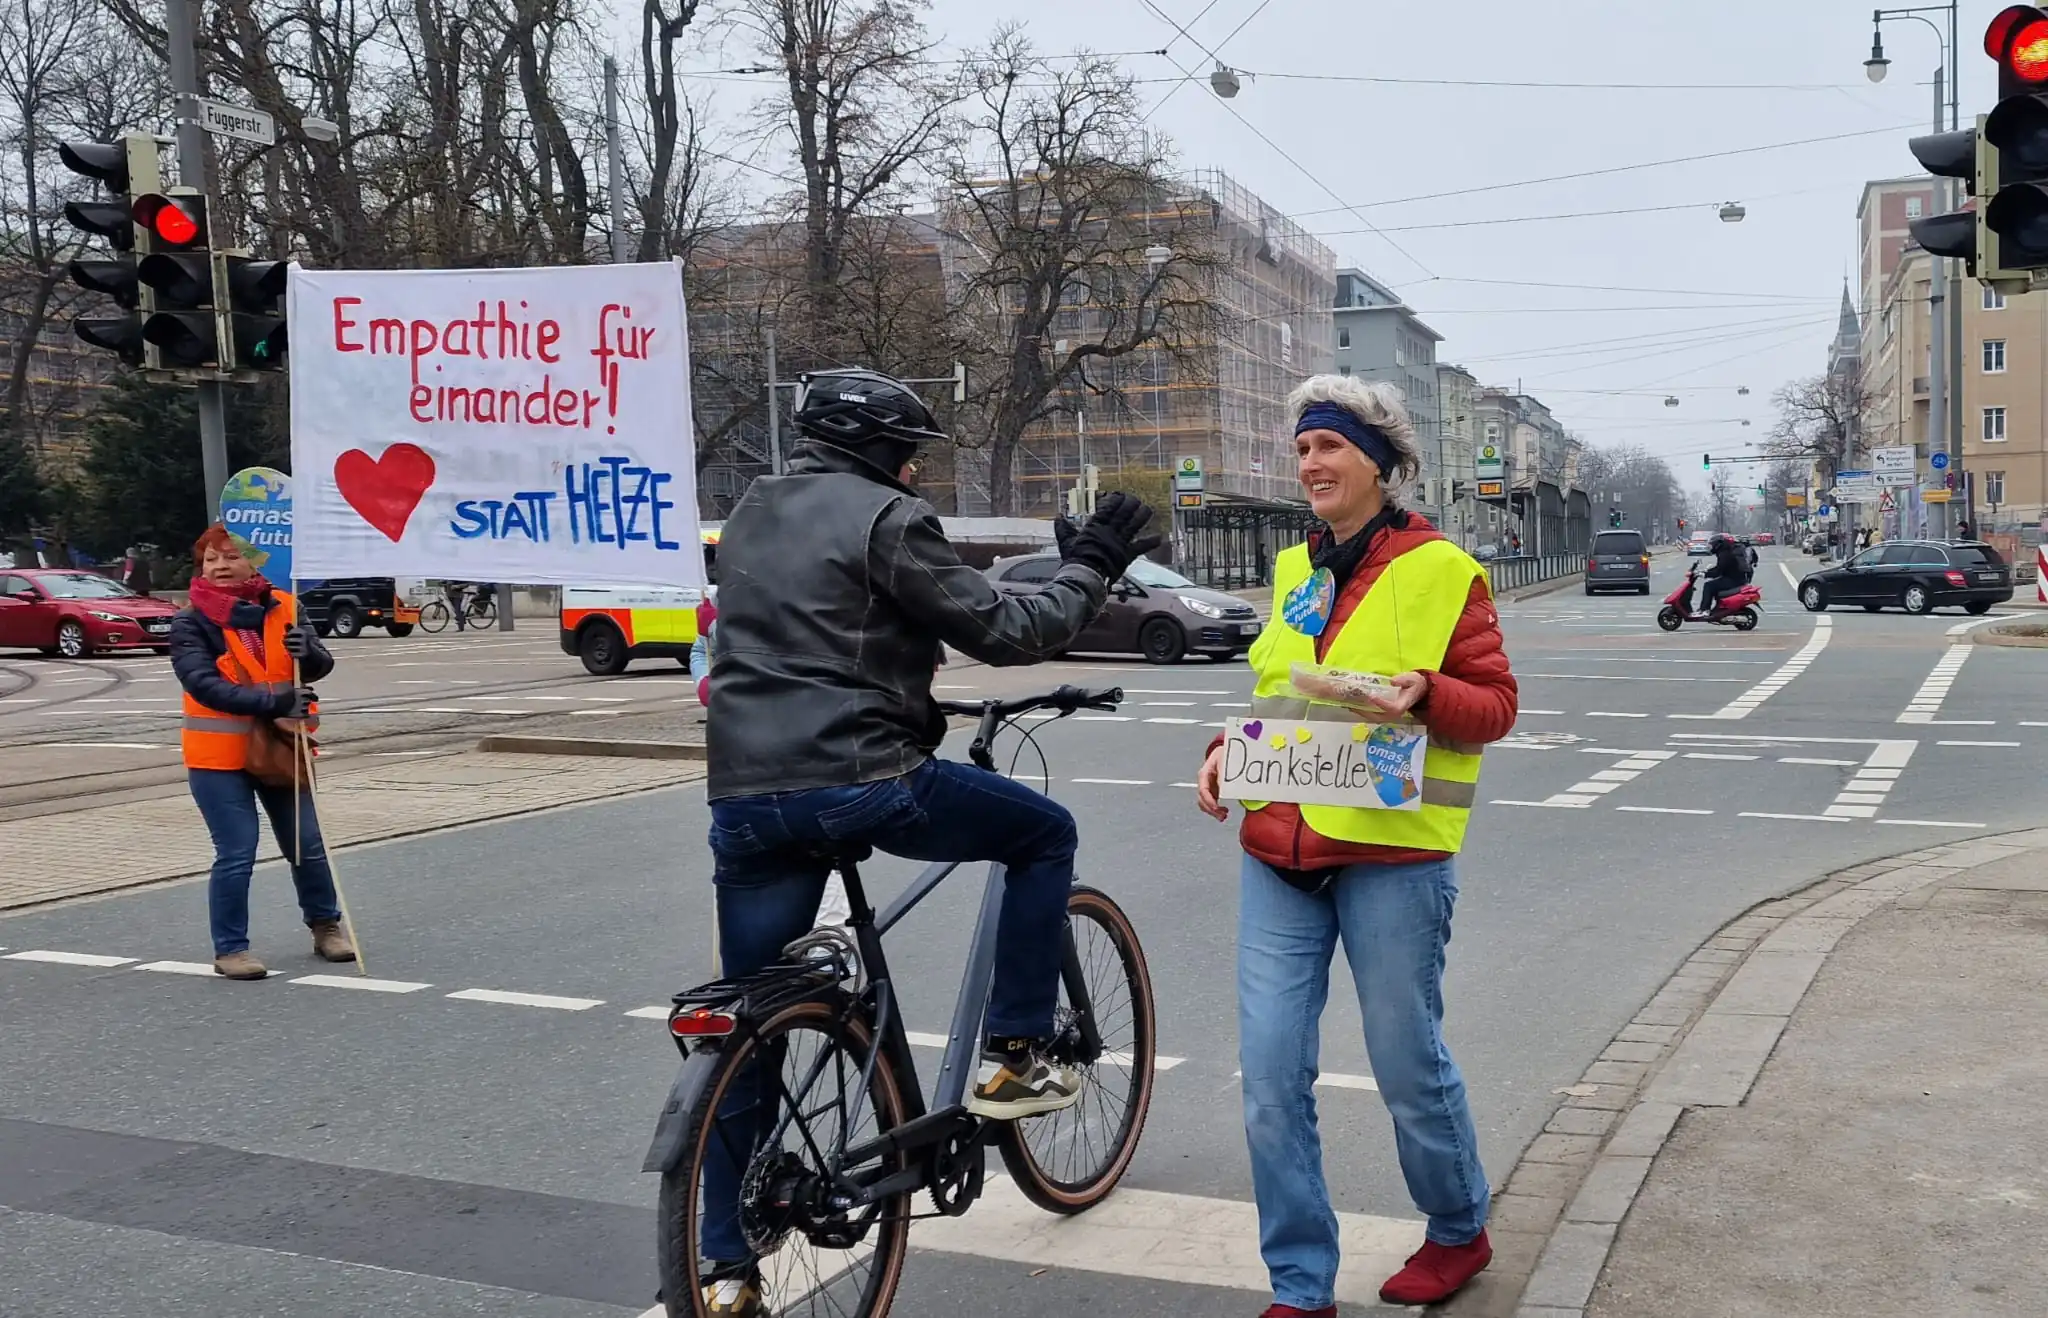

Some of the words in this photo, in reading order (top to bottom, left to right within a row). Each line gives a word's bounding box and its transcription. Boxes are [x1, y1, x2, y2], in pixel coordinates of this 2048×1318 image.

[207, 106, 266, 135] Fuggerstr.
[333, 296, 560, 386] Empathie
[590, 304, 656, 386] für
[409, 362, 619, 435] einander!
[840, 392, 866, 403] uvex
[450, 491, 558, 543] STATT
[566, 456, 680, 551] HETZE
[225, 507, 292, 525] omas
[1284, 600, 1309, 619] omas
[1295, 600, 1321, 623] future
[1224, 737, 1369, 789] Dankstelle
[1368, 745, 1404, 763] omas
[1375, 759, 1413, 781] future
